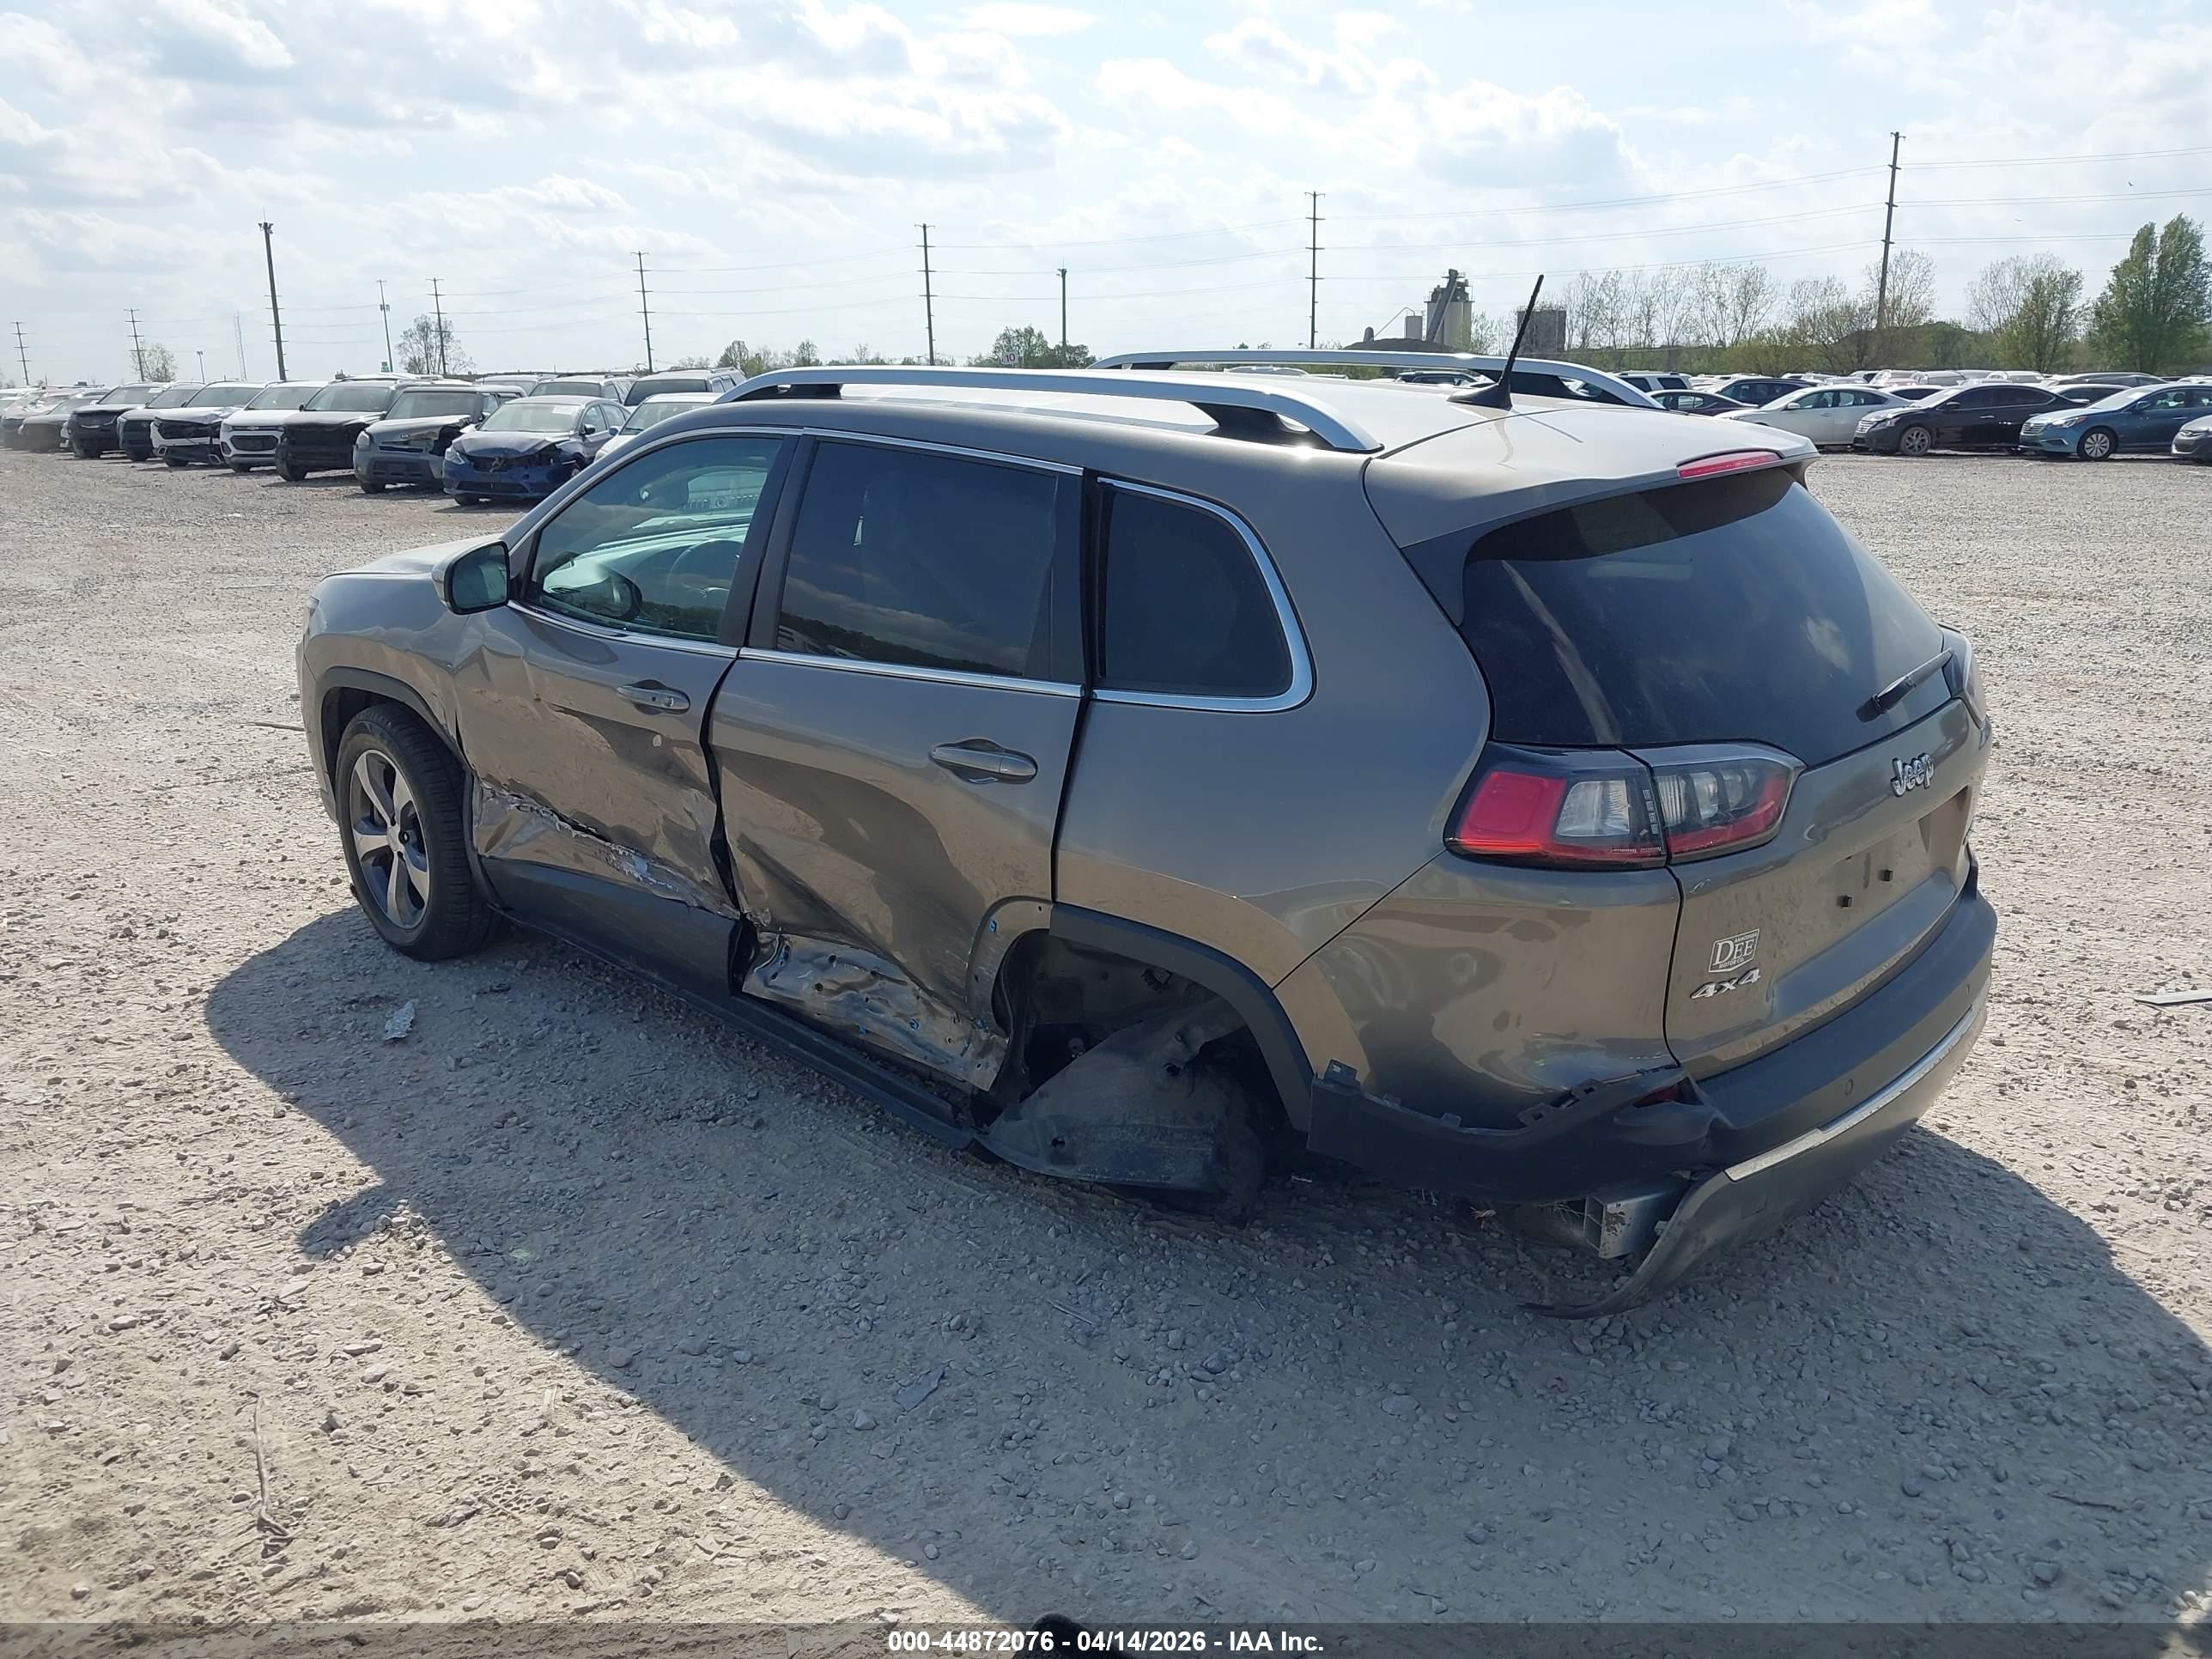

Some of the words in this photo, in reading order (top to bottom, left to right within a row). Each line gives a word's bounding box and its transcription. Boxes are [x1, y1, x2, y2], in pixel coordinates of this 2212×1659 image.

[1890, 753, 1935, 797] Jeep
[1712, 939, 1755, 966] DEE
[1690, 968, 1761, 999] 4x4
